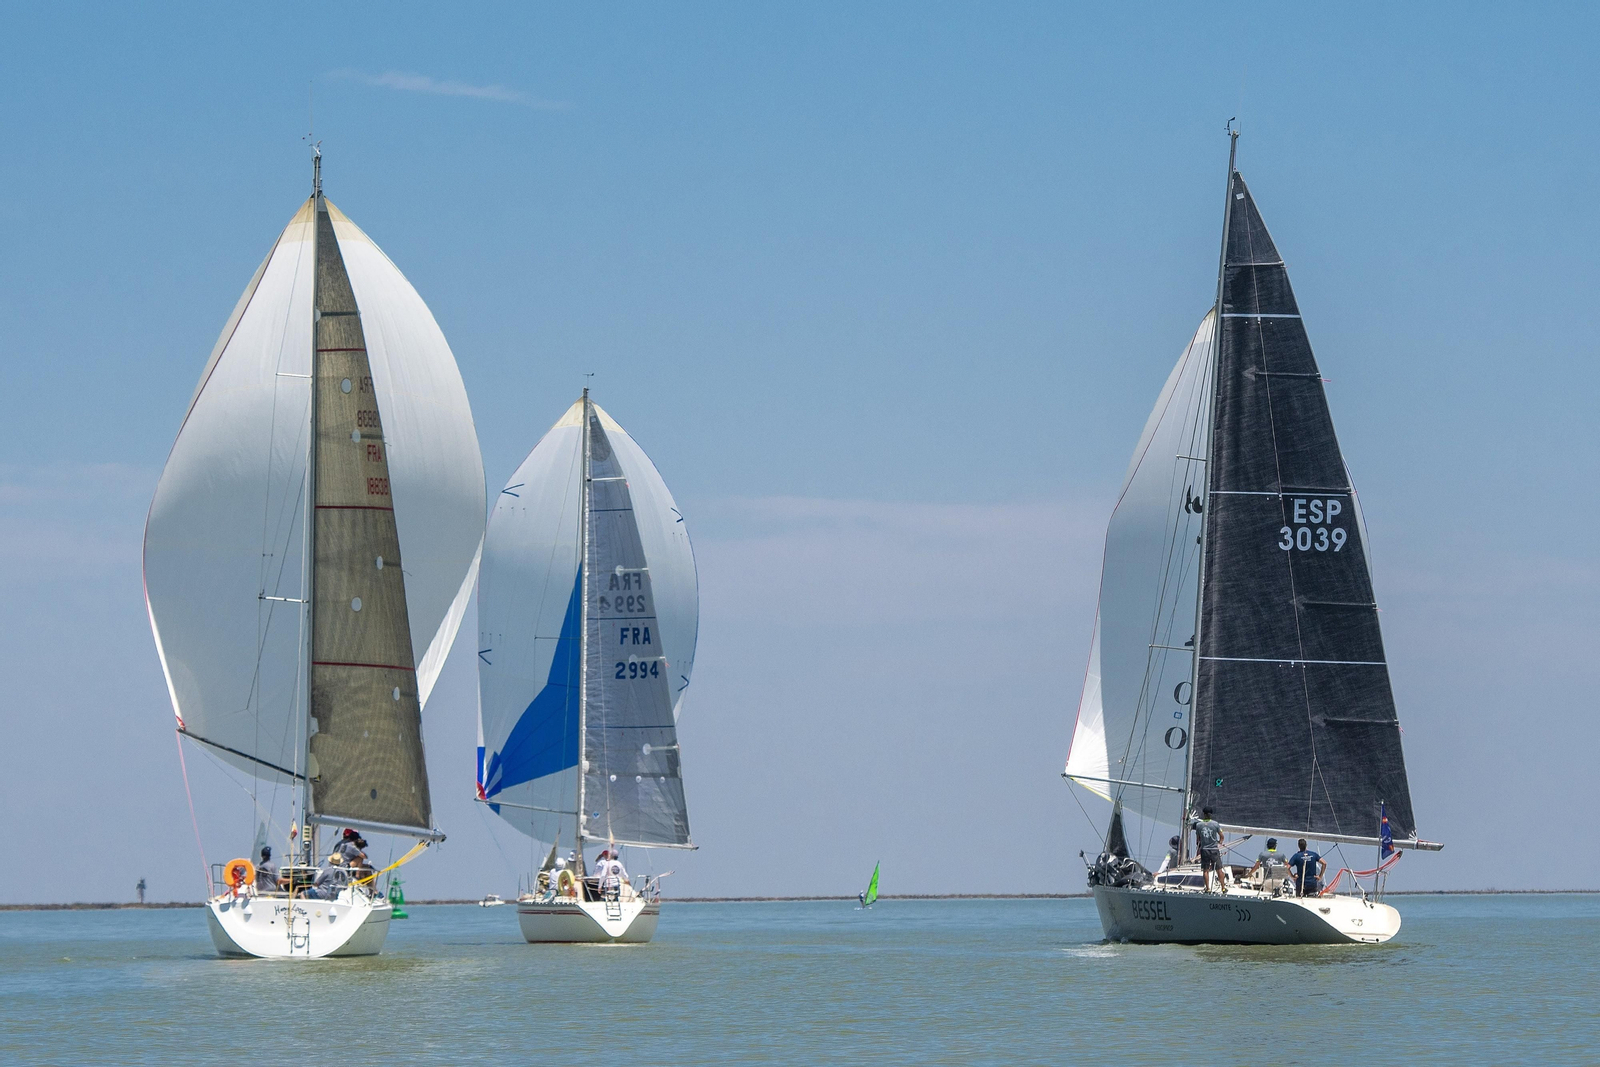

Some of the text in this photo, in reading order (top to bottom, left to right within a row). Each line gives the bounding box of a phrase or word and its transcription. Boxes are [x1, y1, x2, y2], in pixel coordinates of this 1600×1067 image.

[1293, 499, 1342, 524] ESP
[1278, 526, 1347, 552] 3039
[620, 627, 651, 645] FRA
[615, 661, 659, 680] 2994
[1131, 899, 1172, 921] BESSEL
[1209, 903, 1232, 911] CARONTE
